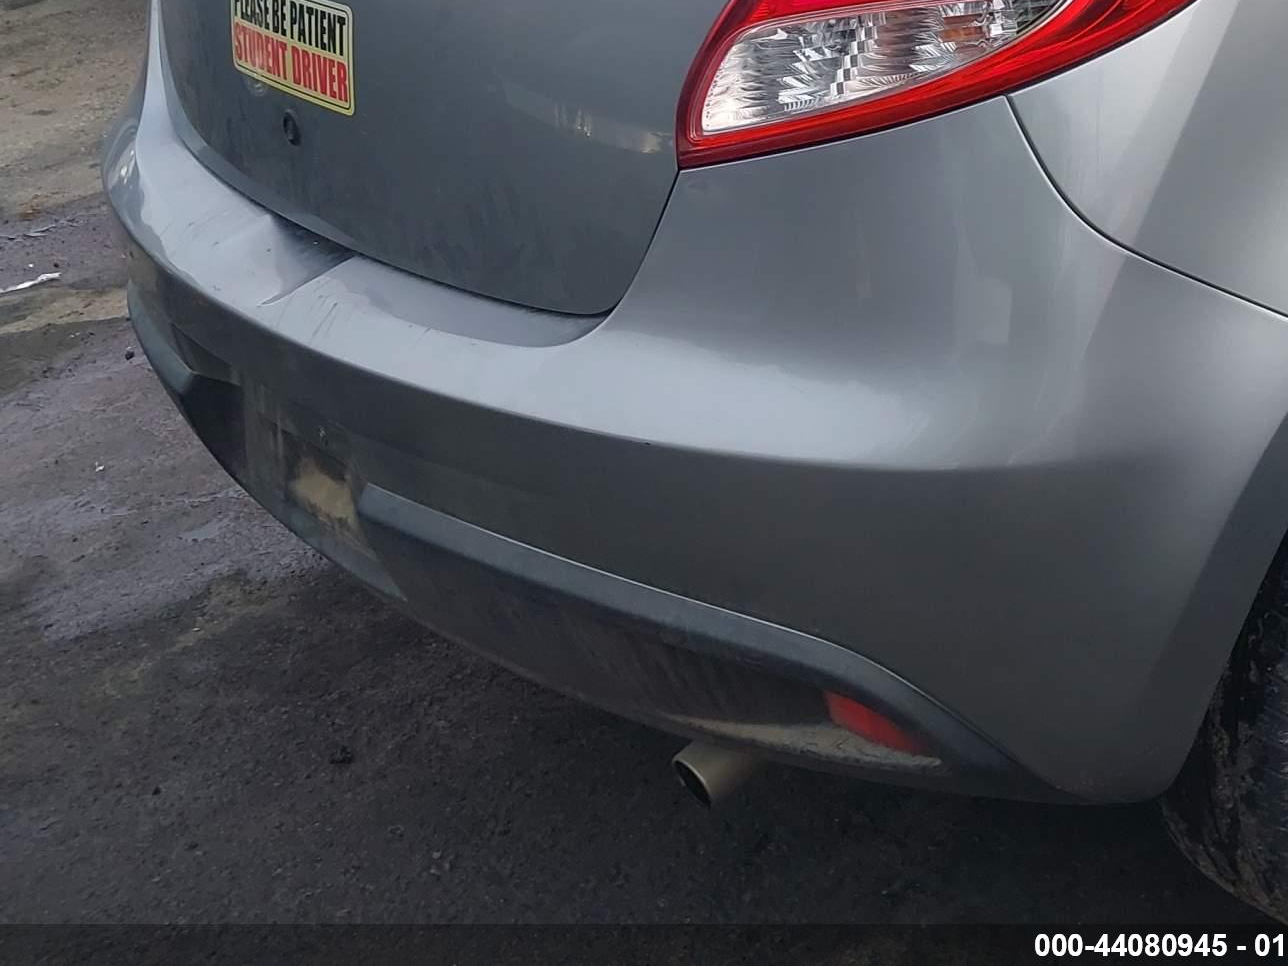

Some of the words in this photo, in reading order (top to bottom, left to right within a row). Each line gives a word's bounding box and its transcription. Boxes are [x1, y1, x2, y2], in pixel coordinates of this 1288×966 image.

[234, 21, 287, 80] STUDENT
[291, 45, 348, 102] DRIVER
[290, 0, 346, 56] PATIENT
